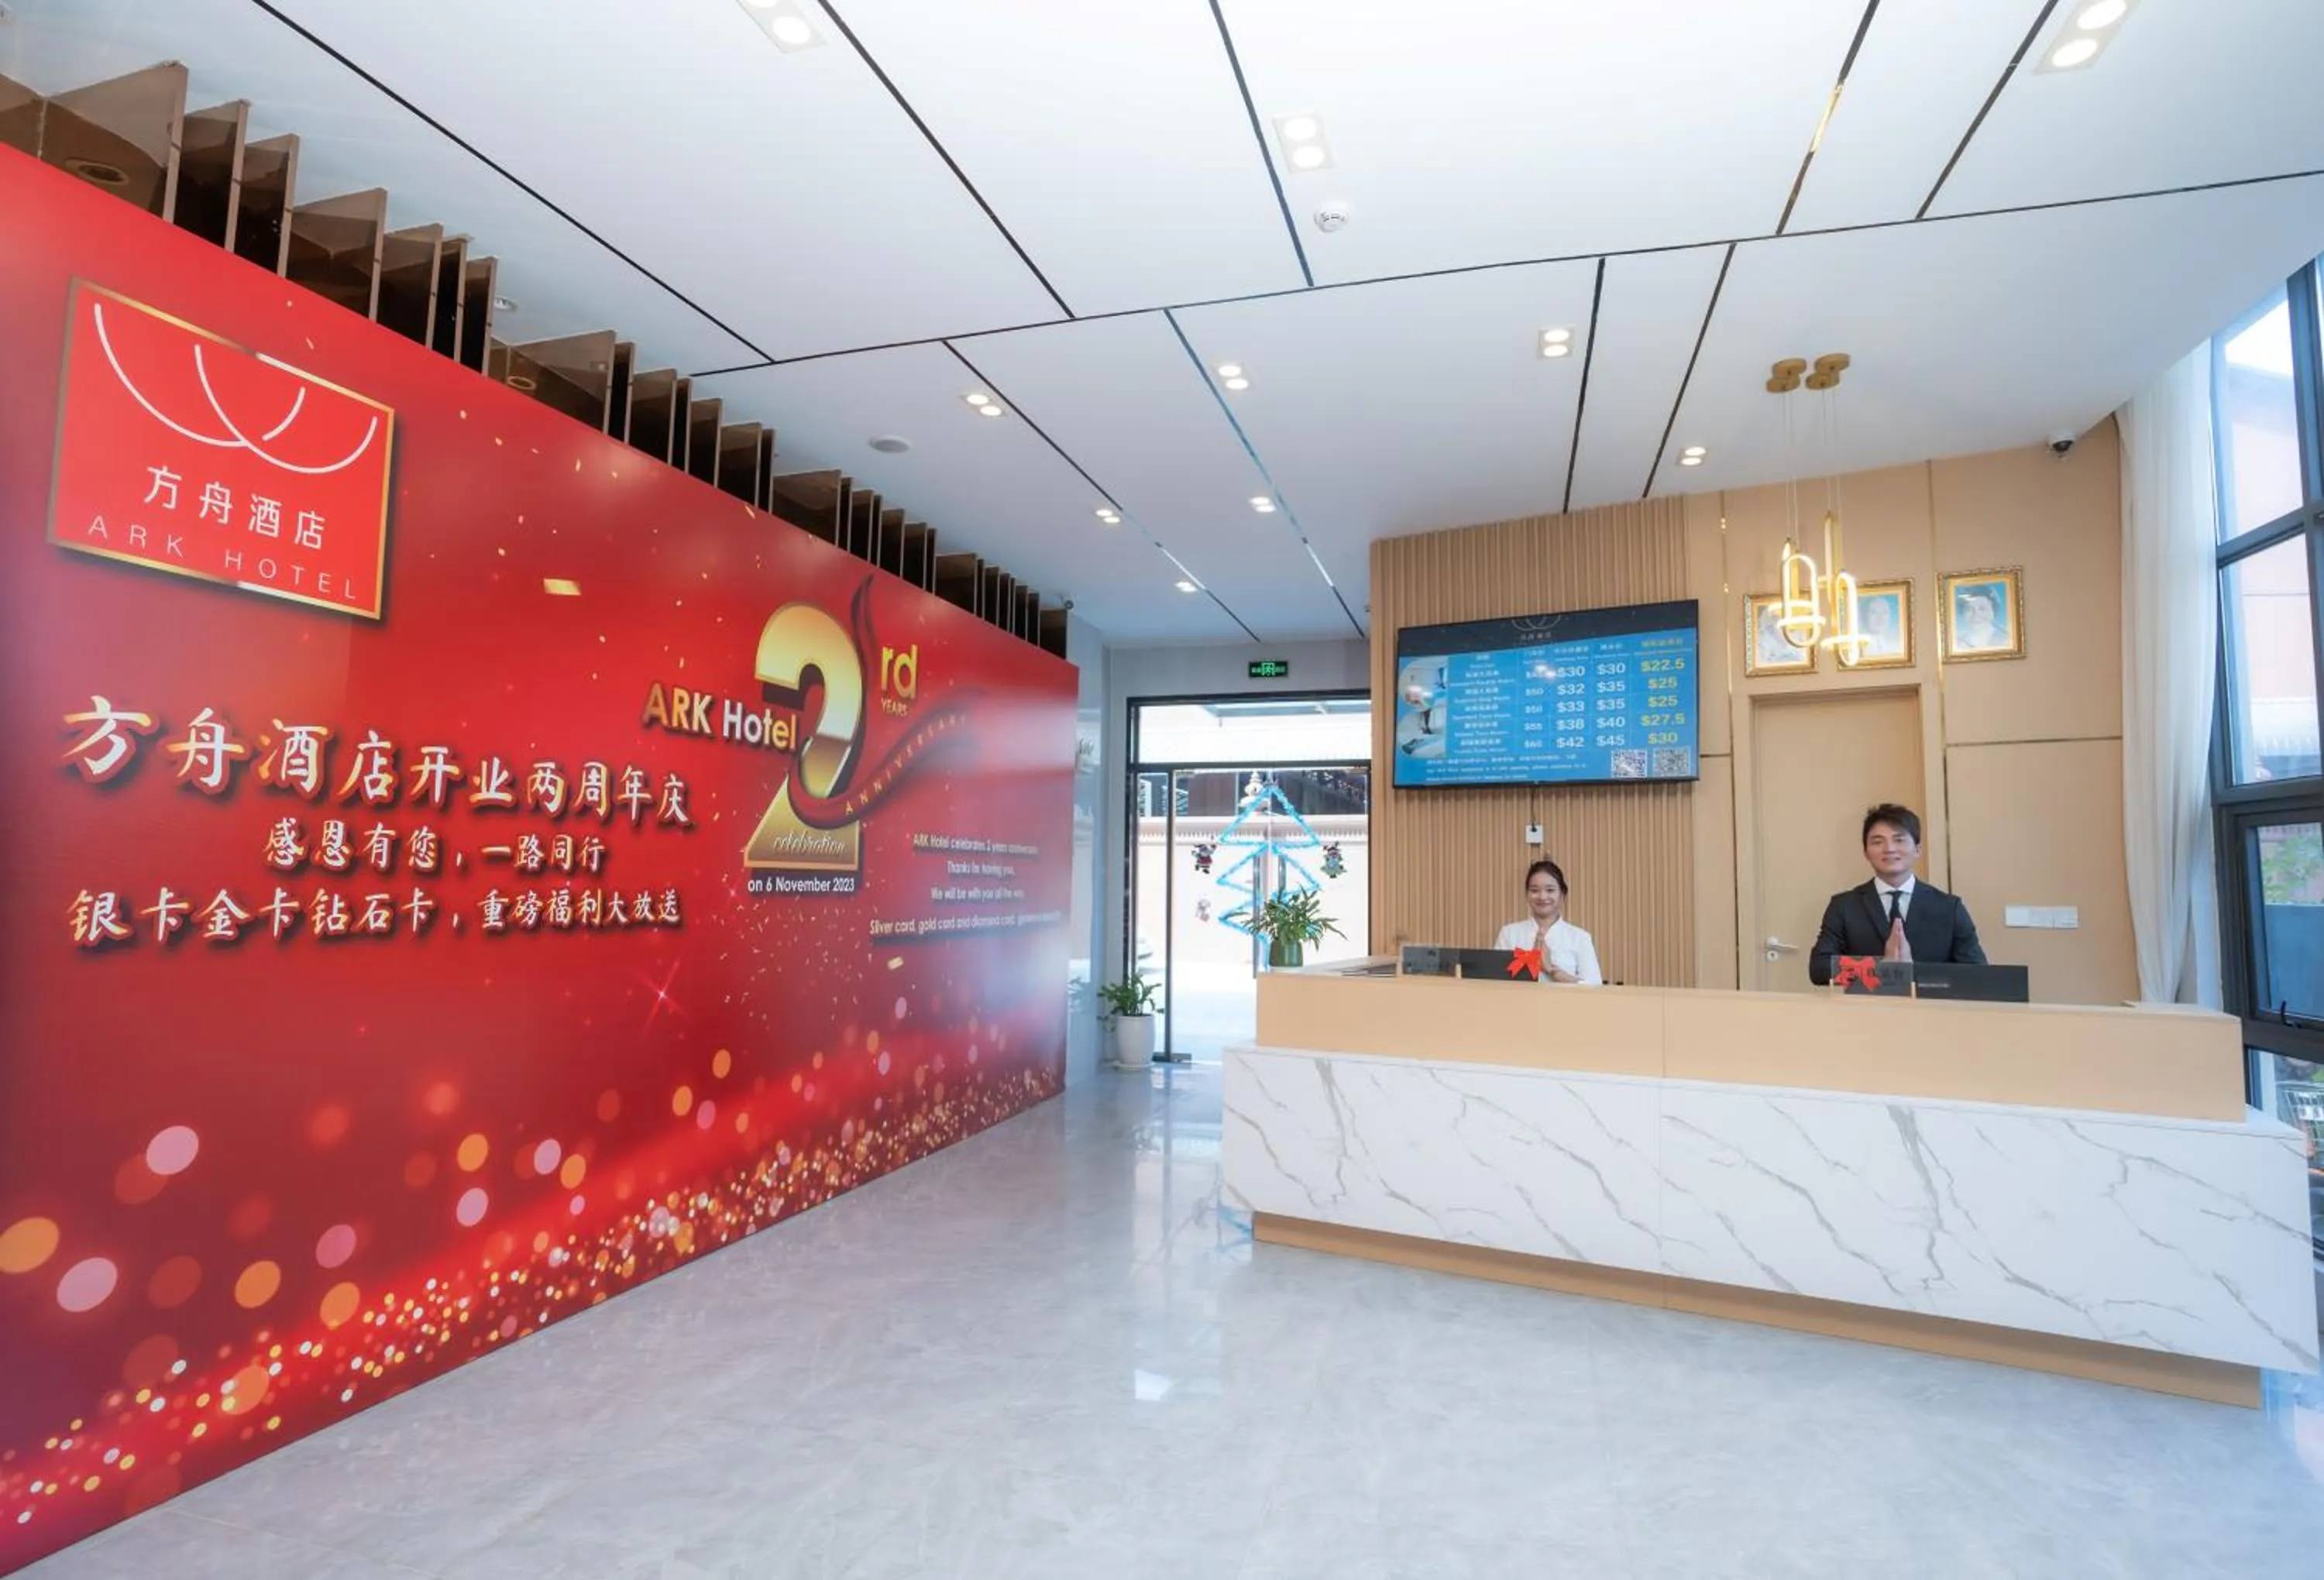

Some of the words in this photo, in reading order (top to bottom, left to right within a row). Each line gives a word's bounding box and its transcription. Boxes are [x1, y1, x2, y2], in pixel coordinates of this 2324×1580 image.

[144, 465, 326, 549] 方舟酒店
[88, 515, 184, 558] ARK
[225, 549, 356, 599] HOTEL
[881, 644, 918, 699] rd
[1556, 665, 1586, 678] $30
[1597, 662, 1626, 675] $30
[1640, 658, 1686, 673] $22.5
[1556, 683, 1585, 696] $32
[1597, 680, 1625, 693] $35
[1648, 676, 1678, 689] $25
[881, 697, 909, 717] YEARS
[1556, 701, 1585, 713] $33
[1597, 698, 1625, 711] $35
[1648, 695, 1678, 708] $25
[642, 682, 713, 734] ARK
[723, 699, 797, 750] Hotel
[1556, 718, 1585, 731] $38
[1597, 716, 1626, 729] $40
[1641, 712, 1686, 727] $27.5
[1556, 737, 1585, 749] $42
[1597, 734, 1625, 747] $45
[1648, 732, 1679, 744] $30
[61, 695, 689, 823] 方舟酒店开业两周年庆
[913, 834, 929, 847] ARK
[930, 835, 950, 849] Hotel
[947, 860, 969, 874] Thanks
[748, 878, 763, 892] on
[766, 876, 773, 892] 6
[775, 876, 831, 892] November
[833, 877, 855, 892] 2023
[931, 887, 943, 900] We
[870, 919, 892, 935] Silver
[918, 916, 937, 935] gold
